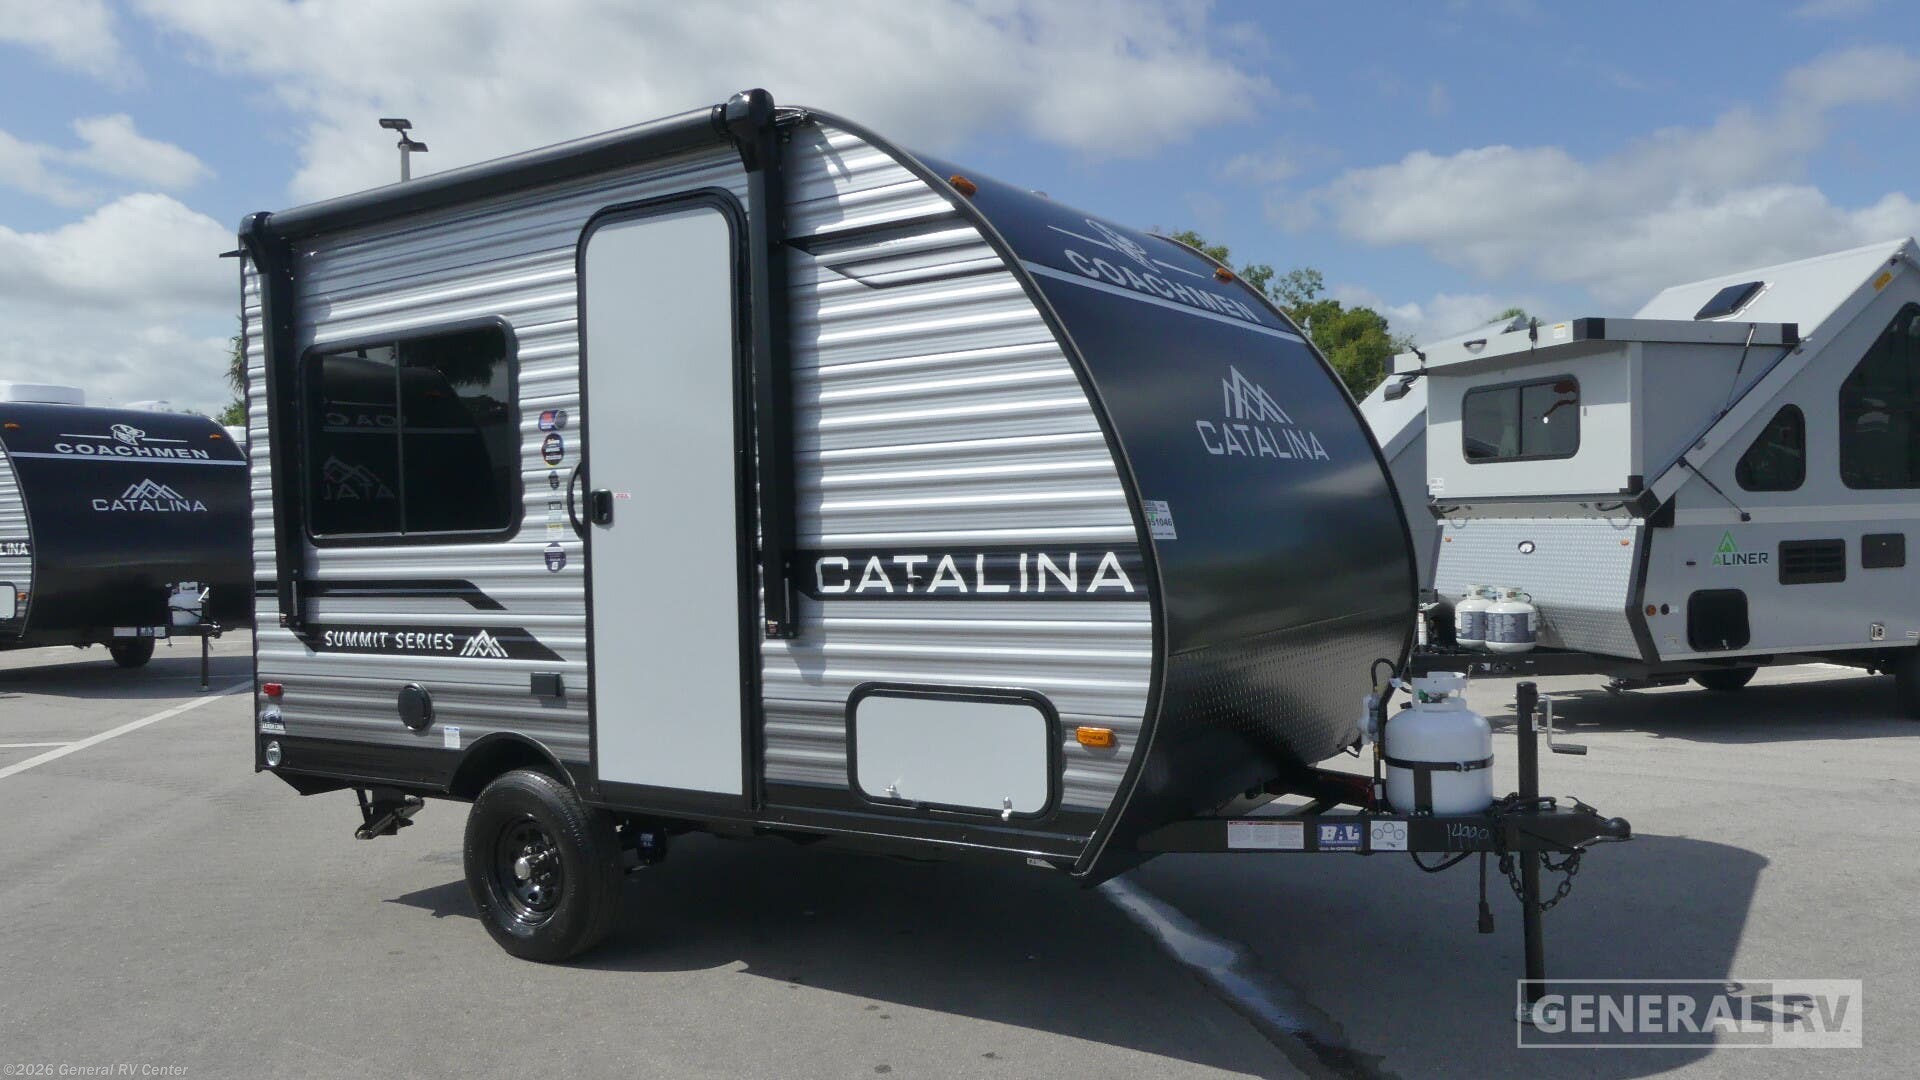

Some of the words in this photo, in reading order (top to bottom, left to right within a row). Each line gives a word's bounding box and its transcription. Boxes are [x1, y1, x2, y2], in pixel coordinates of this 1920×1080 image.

[1063, 249, 1262, 322] COACHMEN
[1196, 420, 1330, 461] CATALINA
[54, 443, 209, 460] COACHMEN
[92, 499, 208, 512] CATALINA
[1712, 552, 1768, 566] ALINER
[815, 551, 1135, 593] CATALINA
[325, 630, 389, 648] SUMMIT
[395, 632, 454, 650] SERIES
